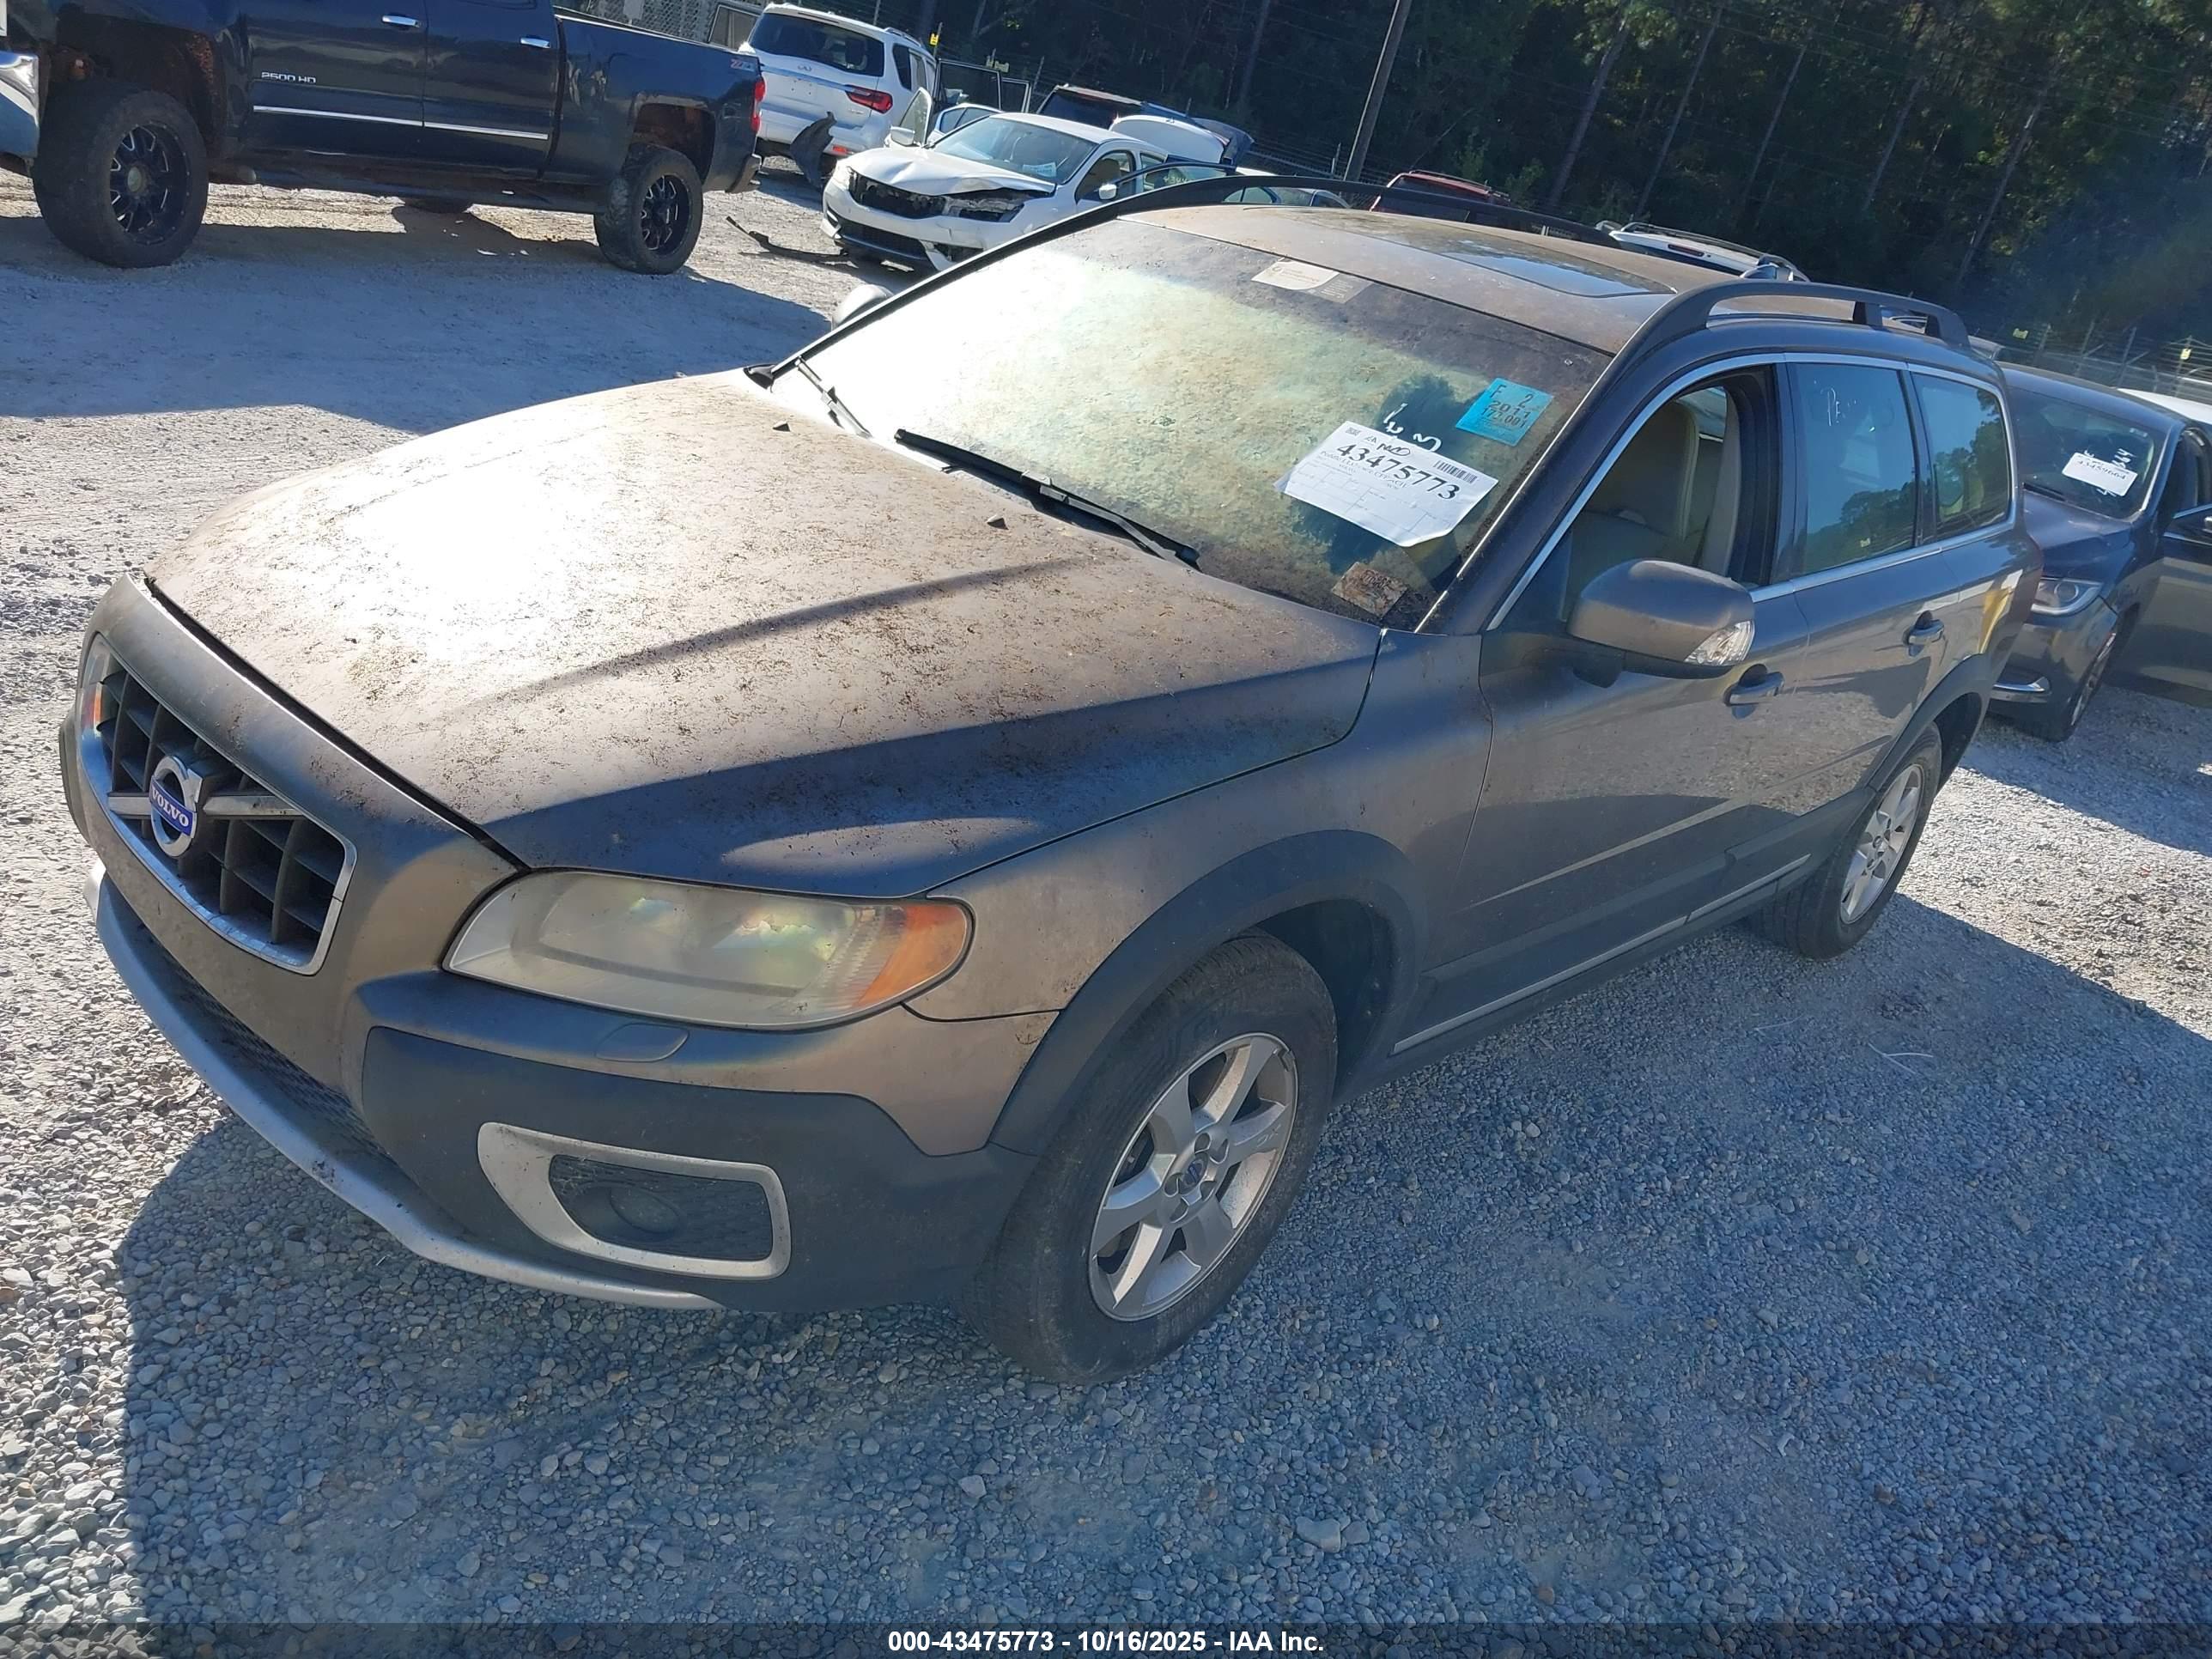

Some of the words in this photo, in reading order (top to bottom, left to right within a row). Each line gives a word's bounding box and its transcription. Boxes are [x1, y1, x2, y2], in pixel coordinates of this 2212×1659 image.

[261, 71, 296, 82] 2500
[298, 75, 317, 84] HD
[1517, 393, 1534, 409] 2
[1336, 444, 1461, 500] 43475773
[151, 786, 190, 828] VOLVO
